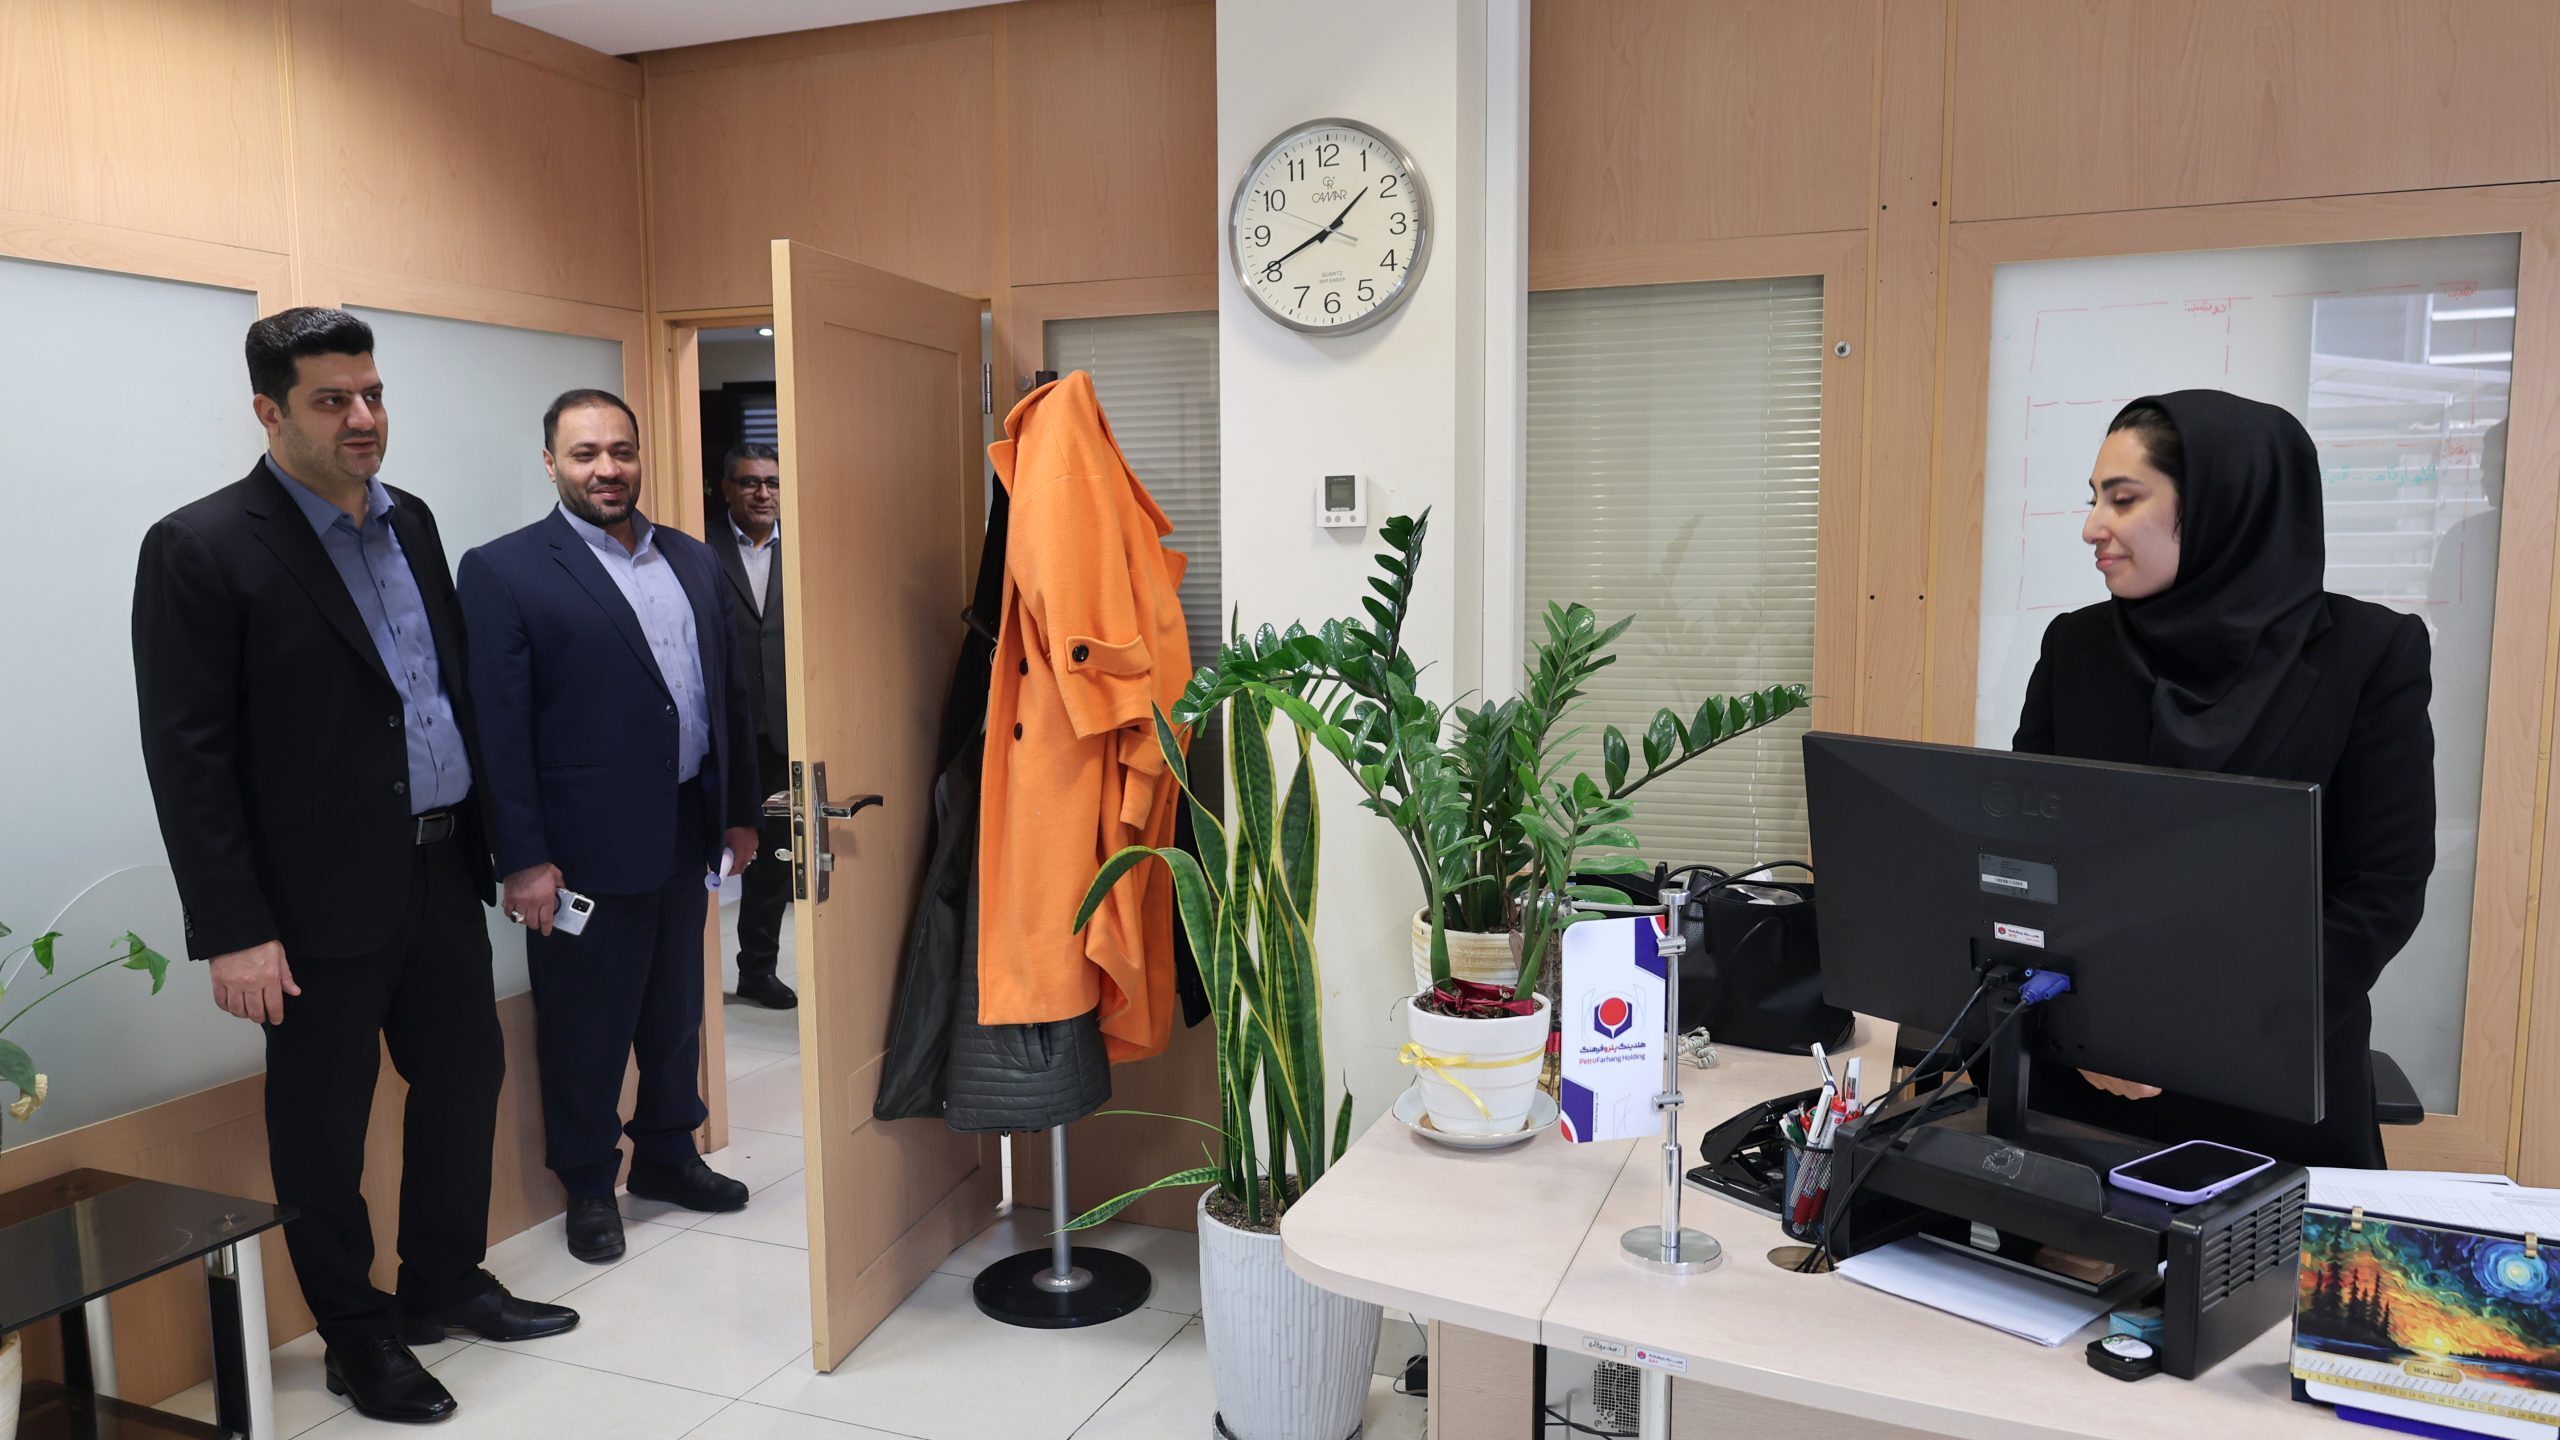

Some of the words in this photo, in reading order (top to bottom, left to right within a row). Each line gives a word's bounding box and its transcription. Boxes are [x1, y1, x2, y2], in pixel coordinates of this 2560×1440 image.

[1316, 143, 1340, 168] 12
[1360, 149, 1367, 172] 1
[1287, 158, 1305, 182] 11
[1312, 189, 1347, 203] CAMAR
[1379, 175, 1398, 199] 2
[1263, 189, 1286, 212] 10
[1389, 212, 1407, 235] 3
[1254, 225, 1271, 247] 9
[1266, 260, 1283, 283] 8
[1379, 249, 1398, 272] 4
[1321, 270, 1343, 278] QUARTZ
[1293, 285, 1311, 309] 7
[1357, 278, 1375, 302] 5
[1324, 291, 1341, 314] 6
[1622, 1053, 1646, 1062] Holding
